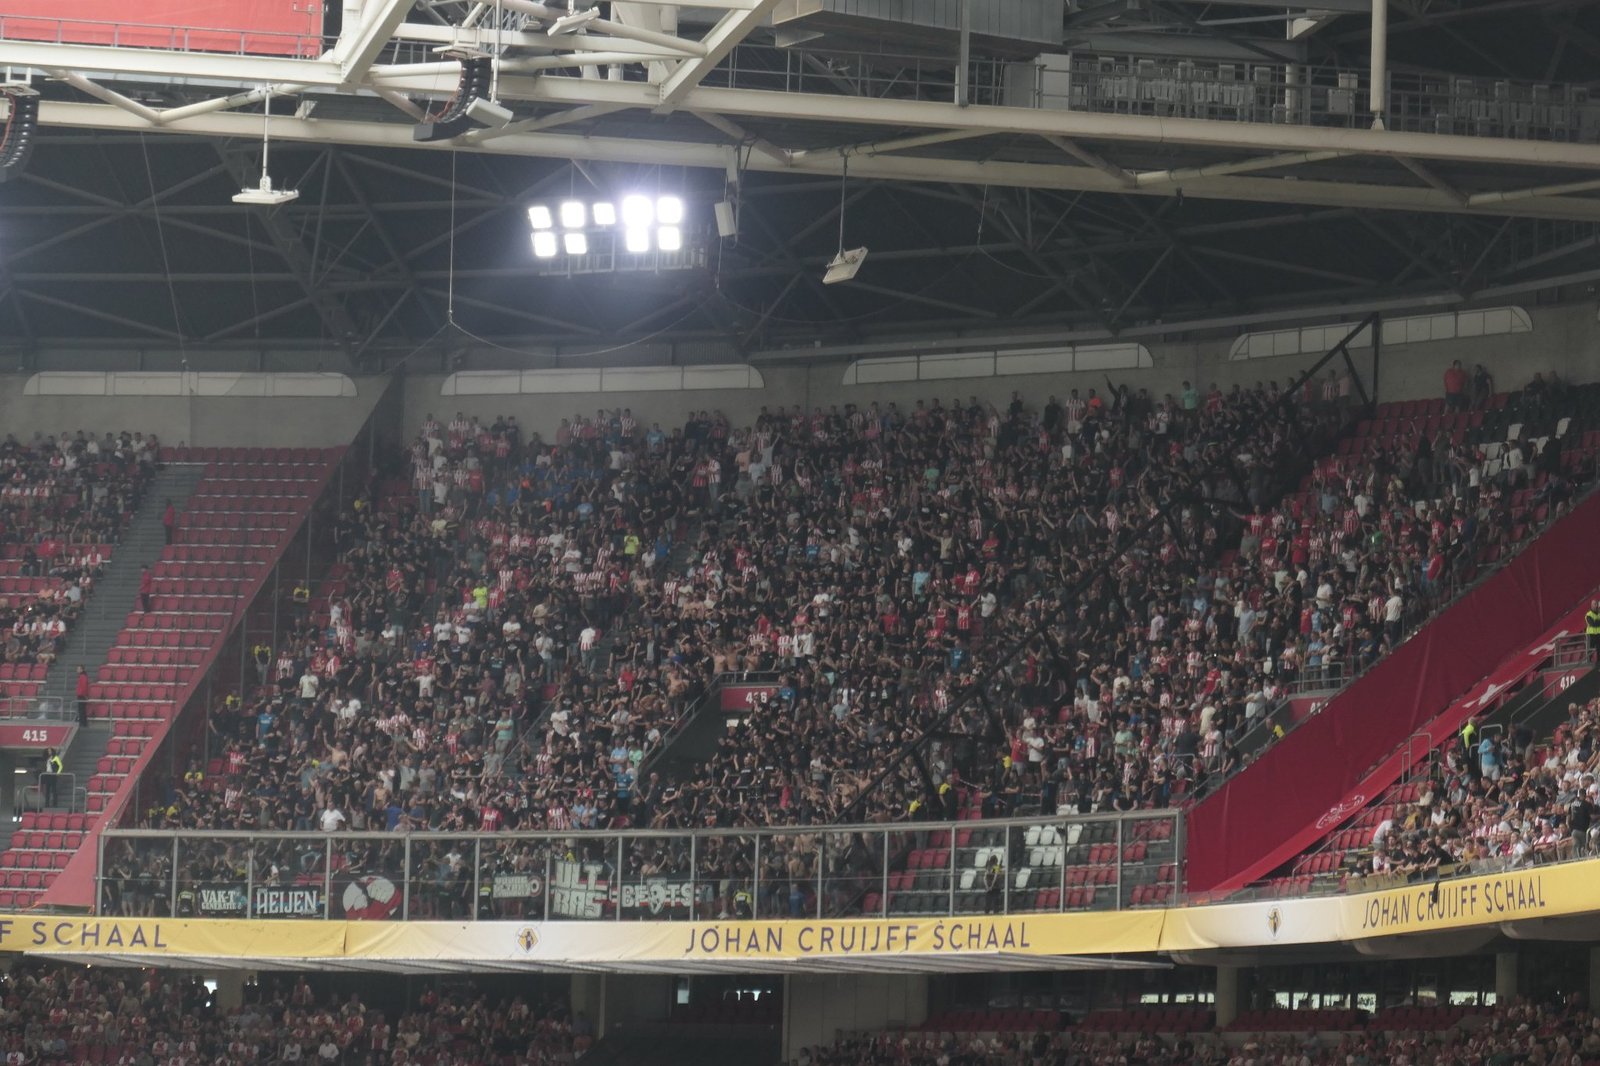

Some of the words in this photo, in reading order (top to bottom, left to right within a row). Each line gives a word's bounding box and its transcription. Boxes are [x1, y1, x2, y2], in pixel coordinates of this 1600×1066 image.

[23, 730, 47, 742] 415
[1362, 893, 1411, 929] JOHAN
[1416, 884, 1477, 922] CRUIJFF
[1484, 875, 1546, 914] SCHAAL
[32, 921, 167, 948] SCHAAL
[685, 927, 783, 953] JOHAN
[798, 925, 919, 953] CRUIJFF
[932, 921, 1031, 951] SCHAAL
